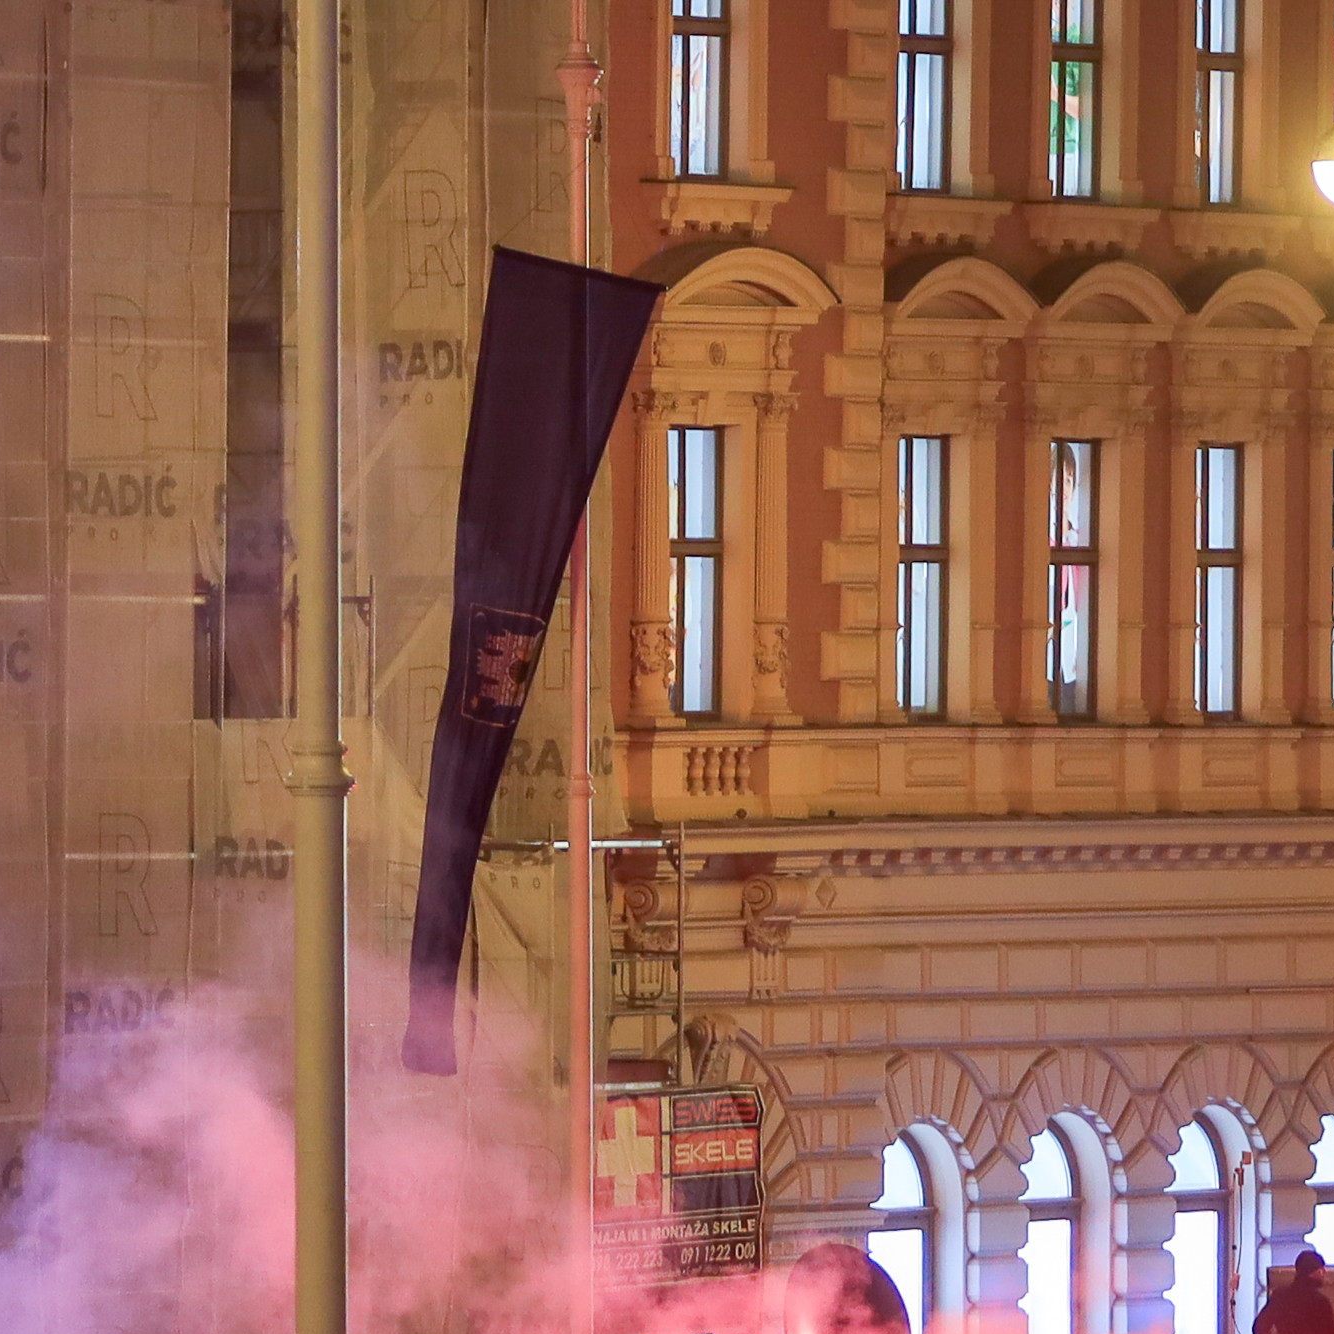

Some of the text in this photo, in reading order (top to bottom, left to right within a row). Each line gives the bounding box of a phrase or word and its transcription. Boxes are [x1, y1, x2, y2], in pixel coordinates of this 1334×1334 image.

[378, 339, 464, 382] RADI
[65, 467, 177, 517] RADIĆ
[214, 837, 290, 881] RAD
[675, 1097, 757, 1125] SWISS
[675, 1138, 753, 1165] SKELE
[713, 1218, 755, 1233] SKELE
